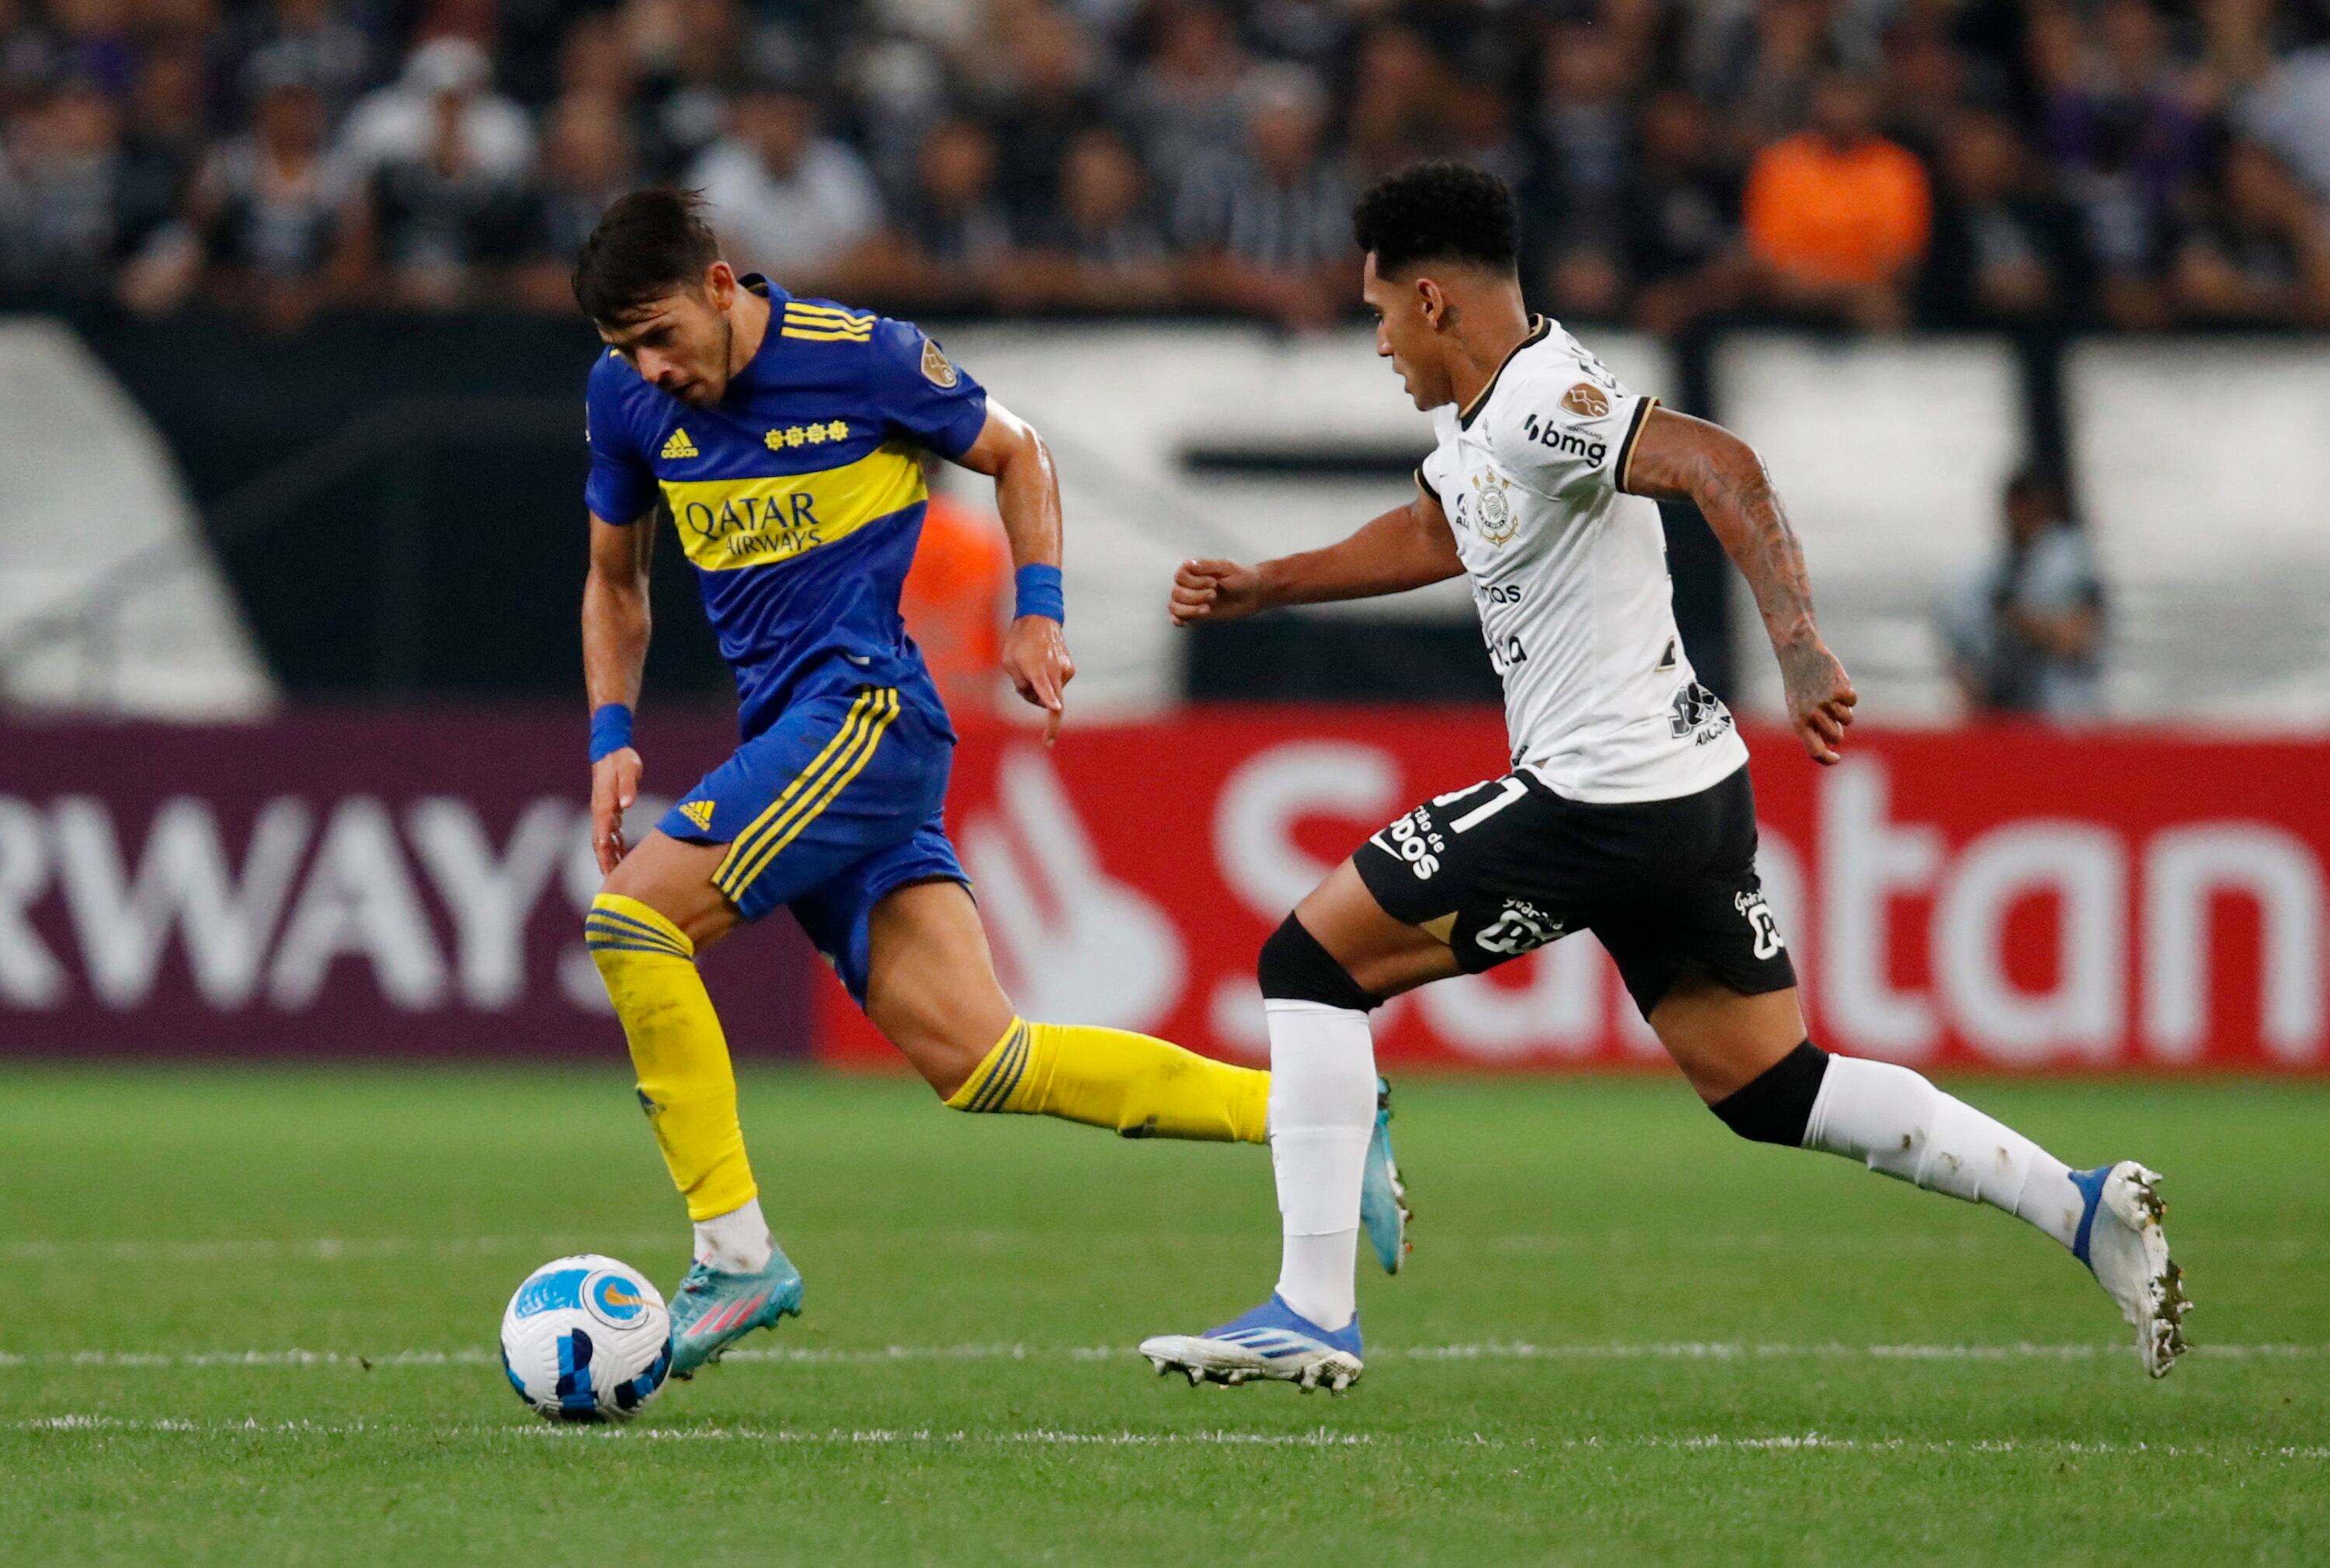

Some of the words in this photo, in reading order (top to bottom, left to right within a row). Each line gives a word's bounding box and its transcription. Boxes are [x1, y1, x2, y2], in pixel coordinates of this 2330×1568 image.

[660, 447, 699, 459] adidas
[1541, 421, 1608, 468] bmg
[686, 492, 820, 541] QATAR
[725, 529, 822, 556] AIRWAYS
[678, 803, 711, 832] adidas
[1427, 832, 1445, 854] de
